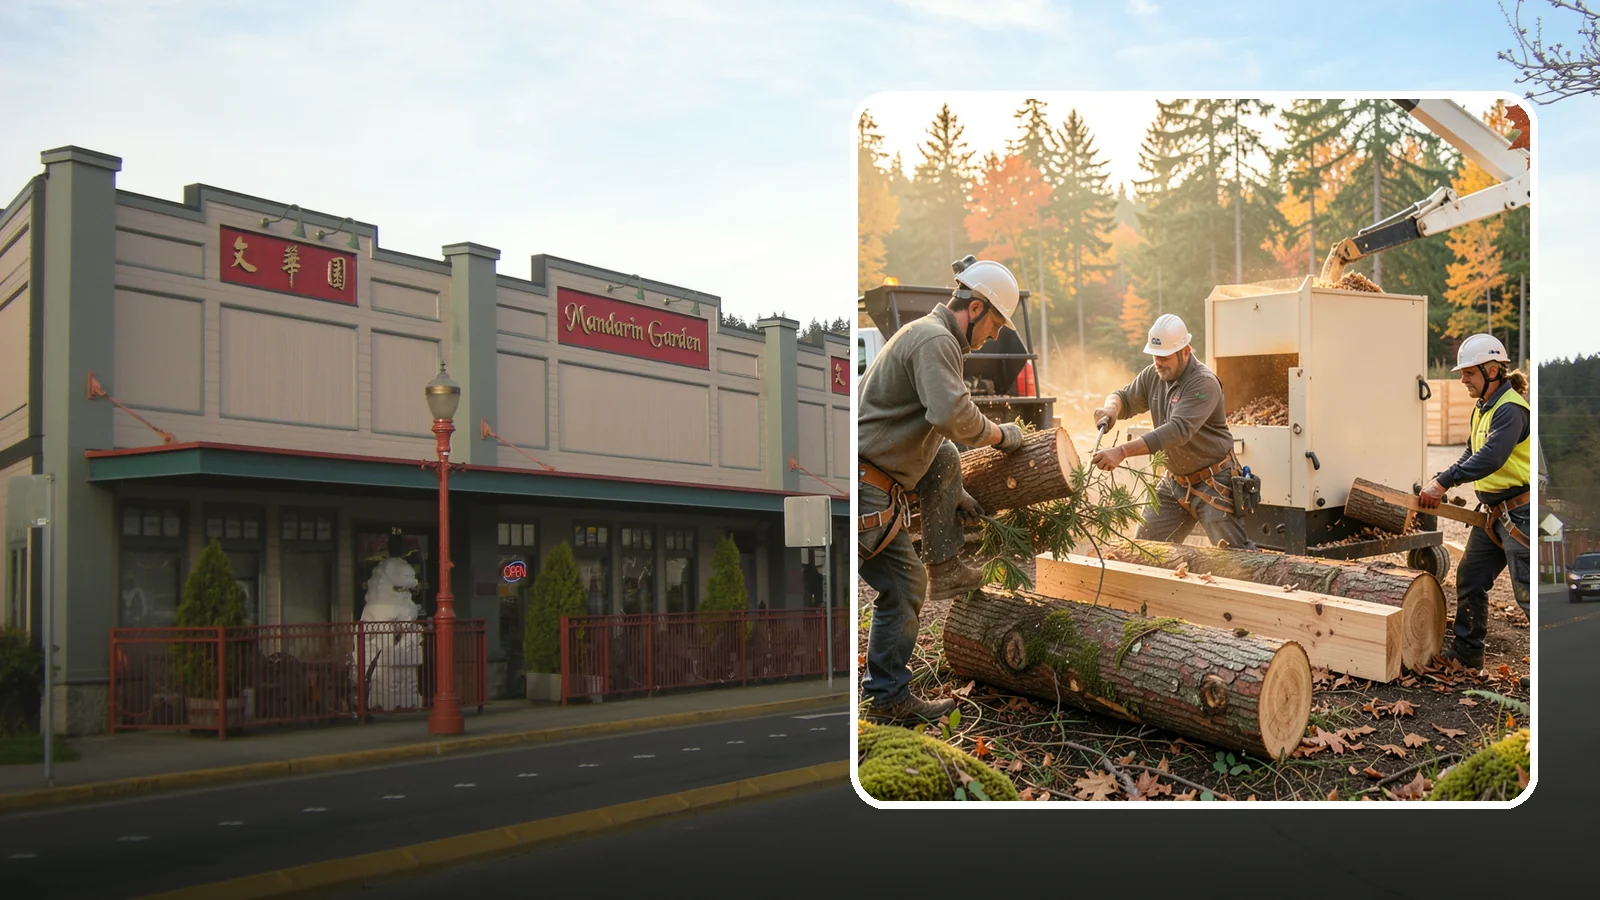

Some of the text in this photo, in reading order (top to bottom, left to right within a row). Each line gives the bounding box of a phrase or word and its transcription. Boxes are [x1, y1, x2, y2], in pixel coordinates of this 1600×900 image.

[564, 302, 702, 352] Mandarin Garden
[503, 565, 527, 579] OPEN
